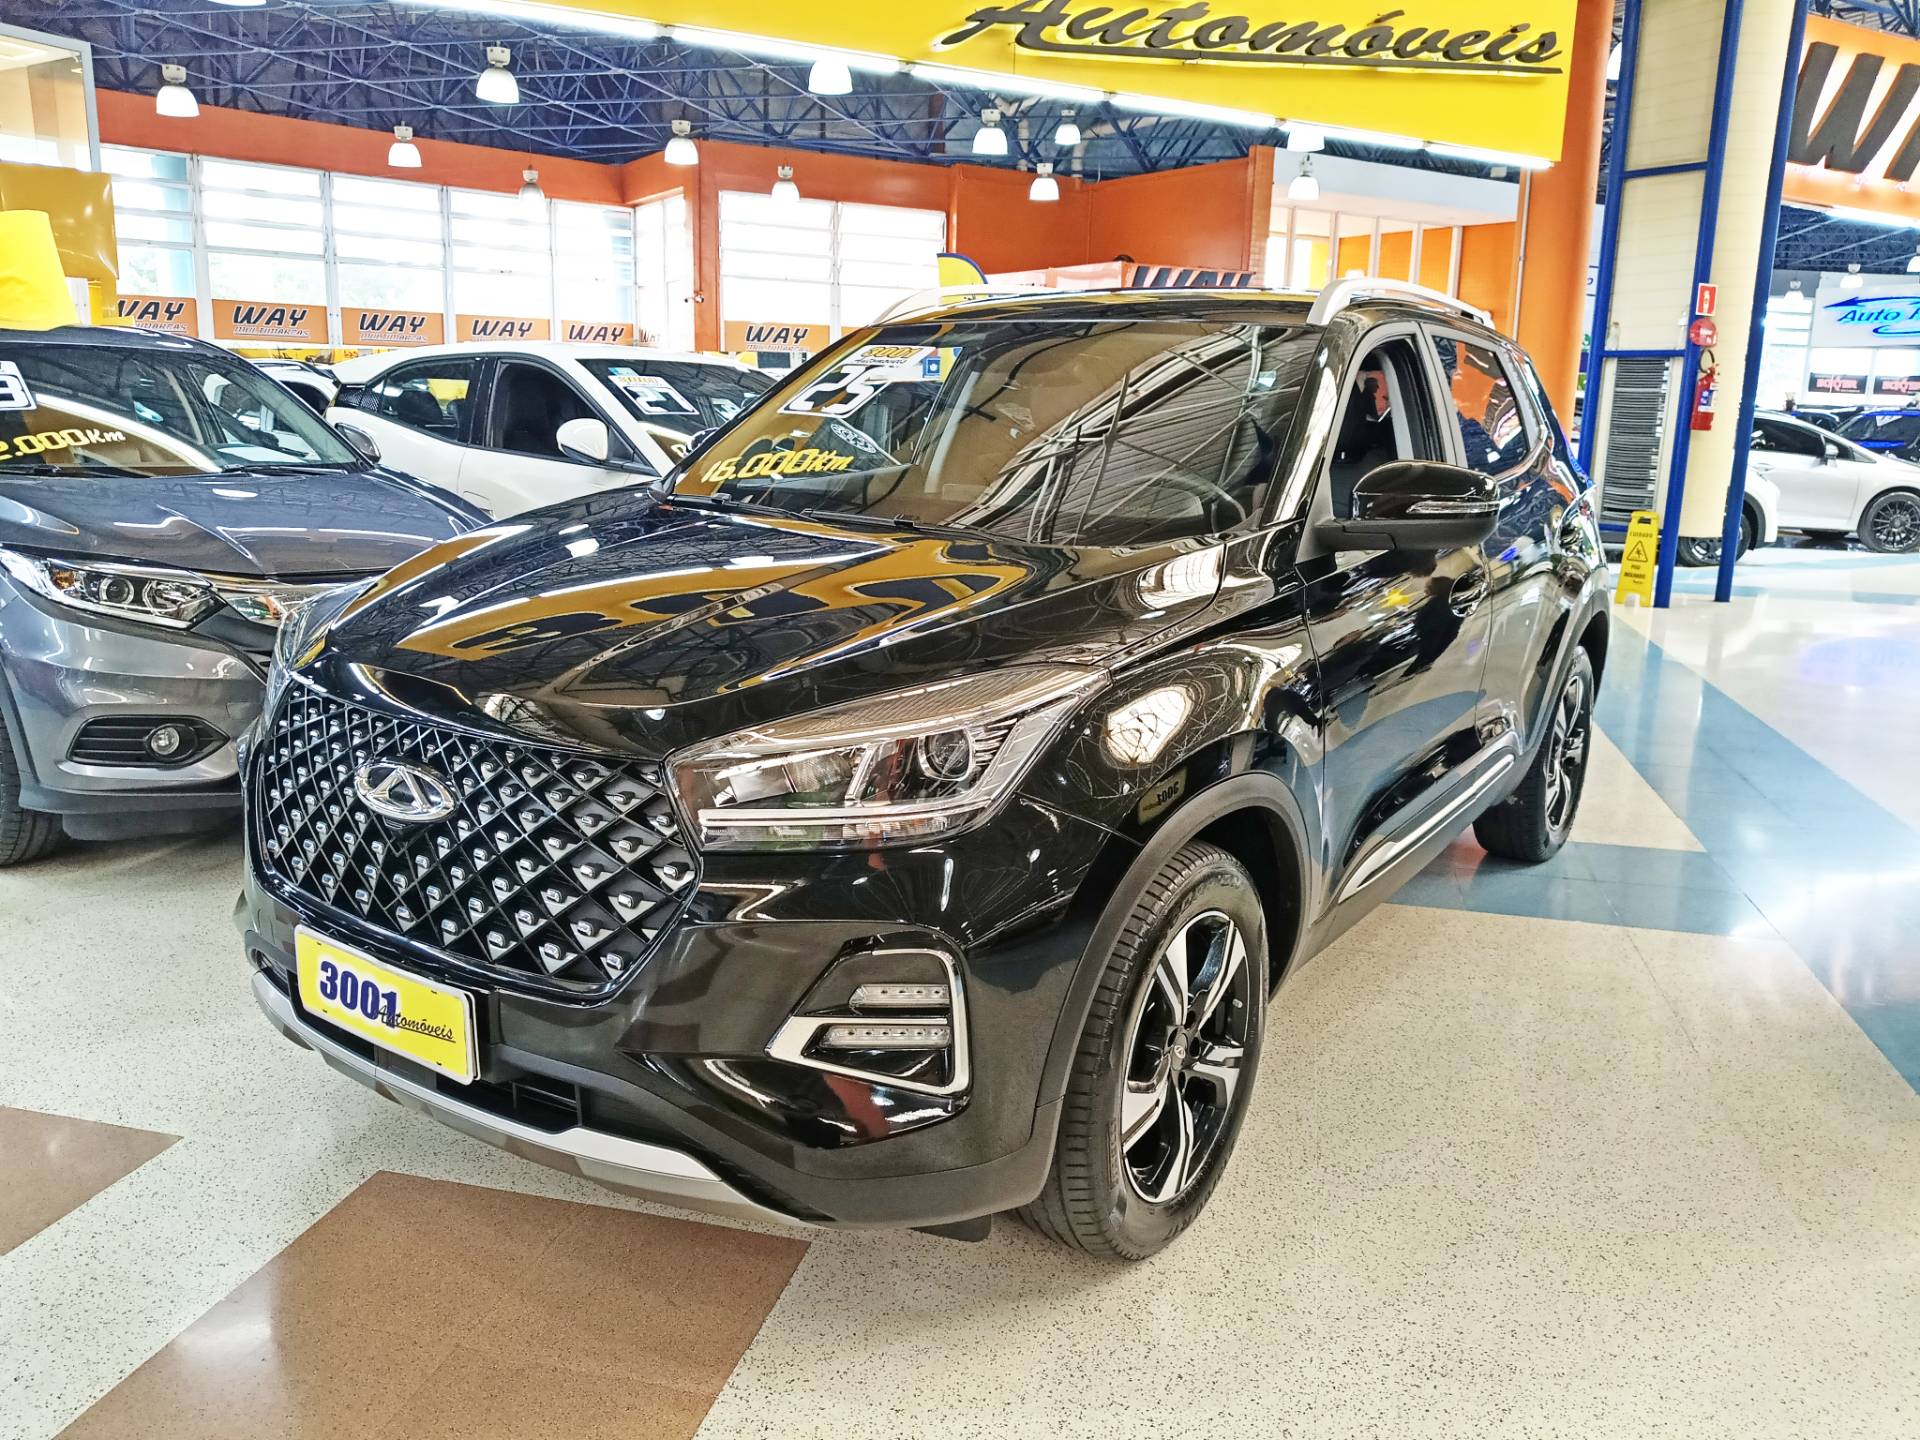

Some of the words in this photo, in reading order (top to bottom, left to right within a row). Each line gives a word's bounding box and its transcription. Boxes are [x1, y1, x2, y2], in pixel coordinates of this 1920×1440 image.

[940, 0, 1562, 72] Automóveis
[1787, 40, 1920, 183] W
[233, 305, 307, 326] WAY
[360, 312, 426, 333] WAY
[1837, 308, 1901, 322] Auto
[472, 319, 534, 337] WAY
[569, 324, 625, 342] WAY
[746, 326, 808, 344] WAY
[788, 365, 886, 415] 25
[320, 960, 398, 1029] 3001
[377, 1004, 456, 1043] Automóveis
